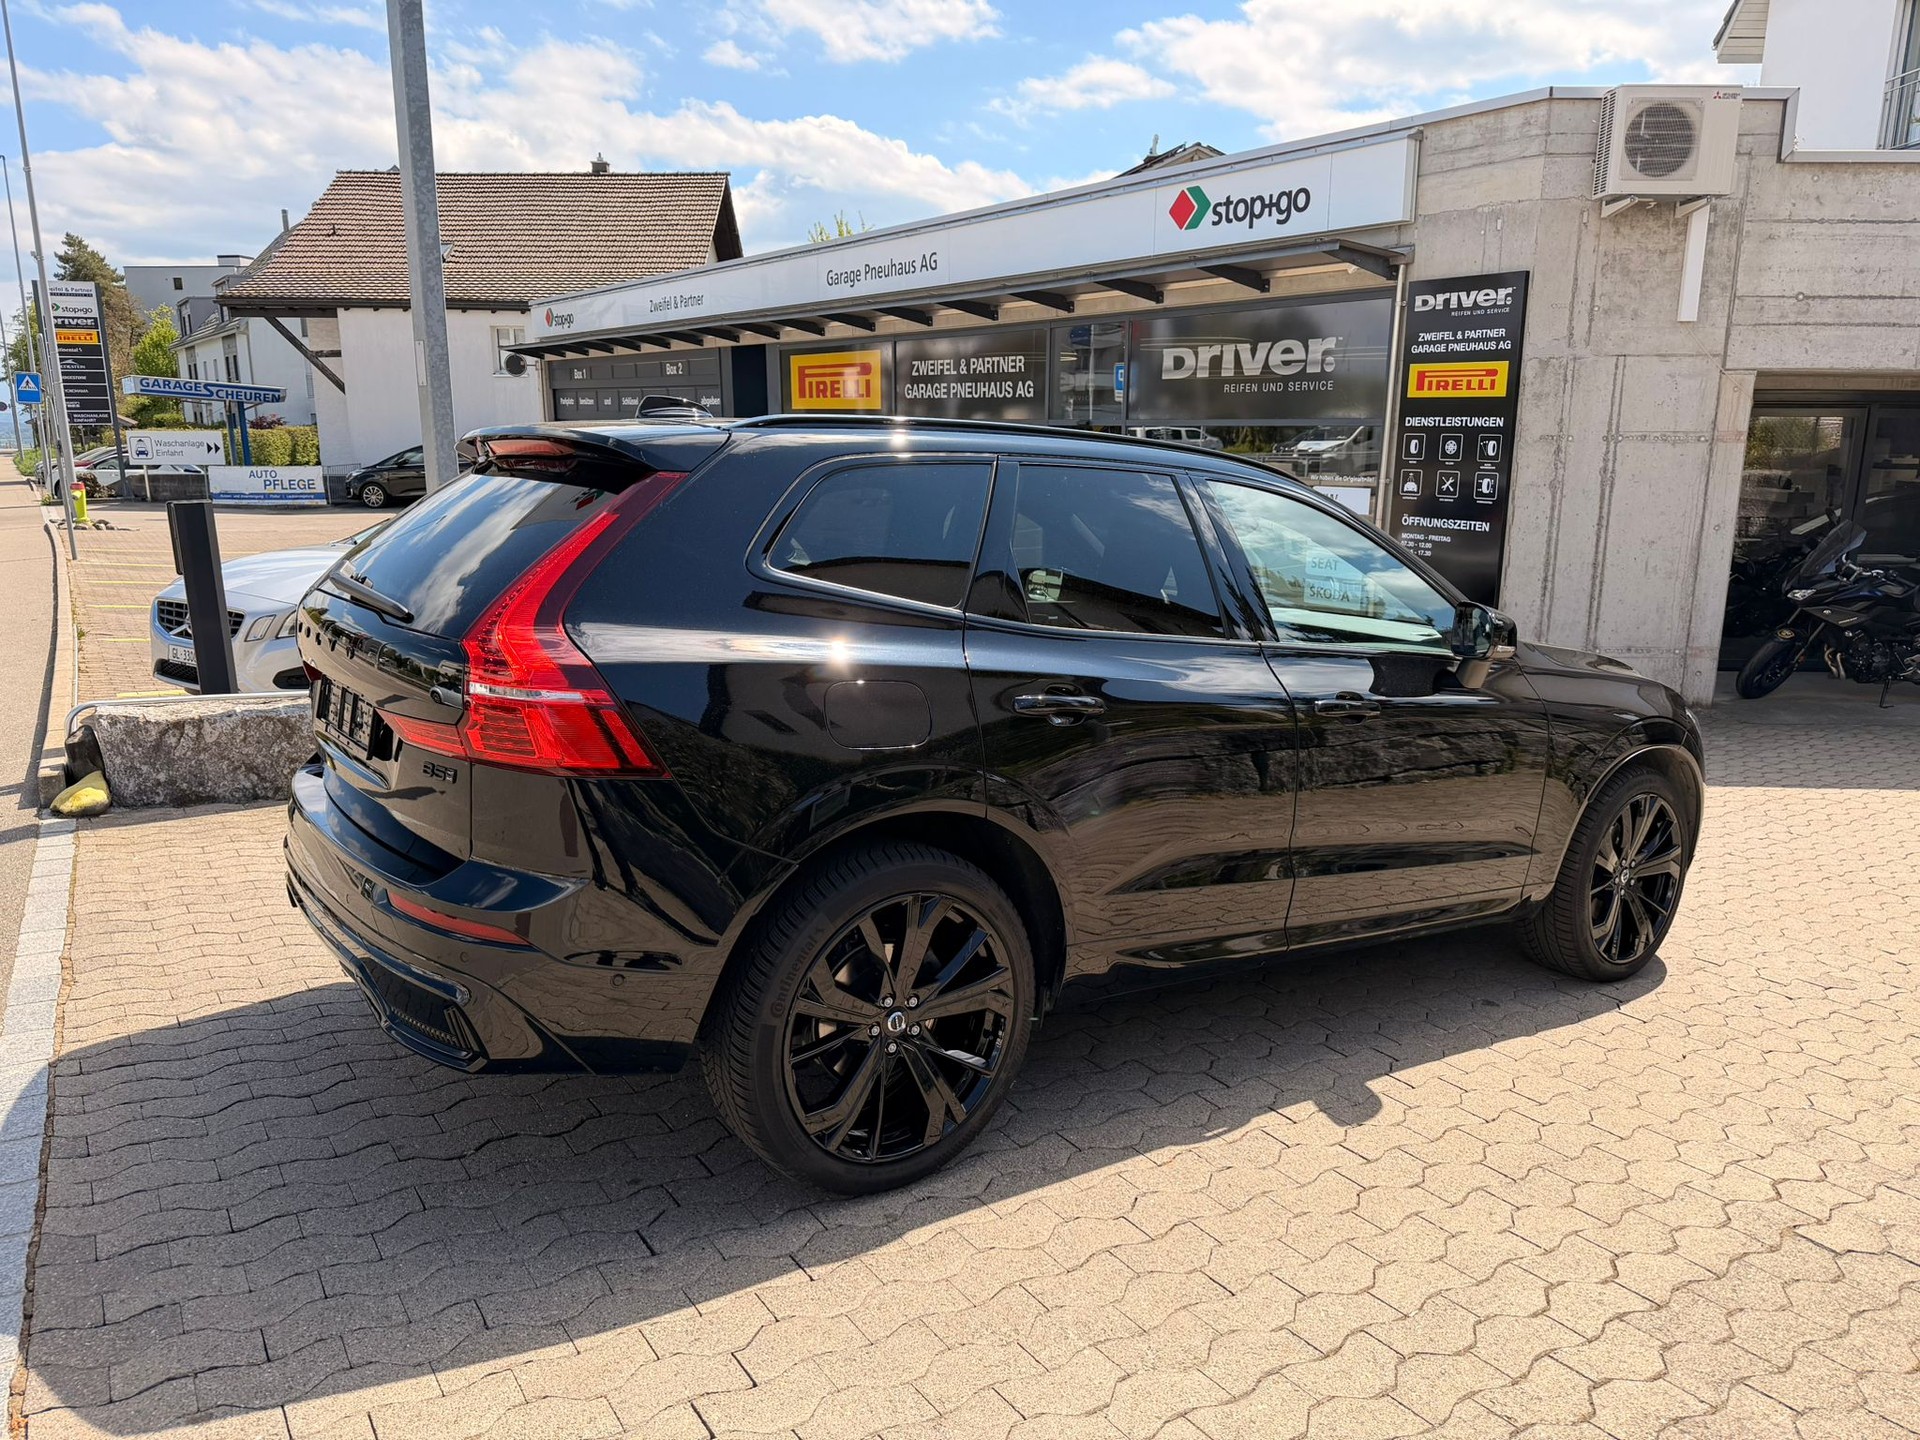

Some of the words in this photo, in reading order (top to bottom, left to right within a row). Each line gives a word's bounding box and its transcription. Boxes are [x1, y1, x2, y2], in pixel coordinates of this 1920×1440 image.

[1212, 187, 1310, 229] stop+go
[826, 267, 860, 288] Garage
[864, 258, 916, 280] Pneuhaus
[920, 252, 938, 272] AG
[650, 297, 672, 313] Zweifel
[674, 297, 679, 309] &
[680, 294, 704, 308] Partner
[1418, 331, 1454, 341] ZWEIFEL
[1456, 331, 1462, 339] &
[1465, 329, 1506, 339] PARTNER
[1411, 344, 1446, 354] GARAGE
[1448, 342, 1496, 352] PNEUHAUS
[1499, 341, 1511, 350] AG
[666, 363, 676, 375] Box
[678, 362, 683, 374] 2
[912, 360, 956, 376] ZWEIFEL
[960, 360, 967, 374] &
[970, 355, 1025, 374] PARTNER
[574, 369, 582, 379] Box
[583, 368, 586, 379] 1
[798, 362, 872, 398] PIRELLI
[1416, 369, 1499, 391] PIRELLI
[140, 378, 202, 392] GARAGE
[904, 382, 948, 399] GARAGE
[950, 381, 1013, 398] PNEUHAUS
[1015, 380, 1034, 397] AG
[1224, 383, 1258, 393] REIFEN
[1263, 382, 1283, 392] UND
[1288, 380, 1334, 391] SERVICE
[1405, 417, 1504, 427] DIENSTLEISTUNGEN
[154, 439, 205, 449] Waschanlage
[156, 449, 184, 457] Einfahrt
[248, 469, 278, 479] AUTO
[263, 479, 316, 490] PFLEGE
[1402, 514, 1490, 532] ÖFFNUNGSZEITEN
[1311, 557, 1338, 571] SEAT
